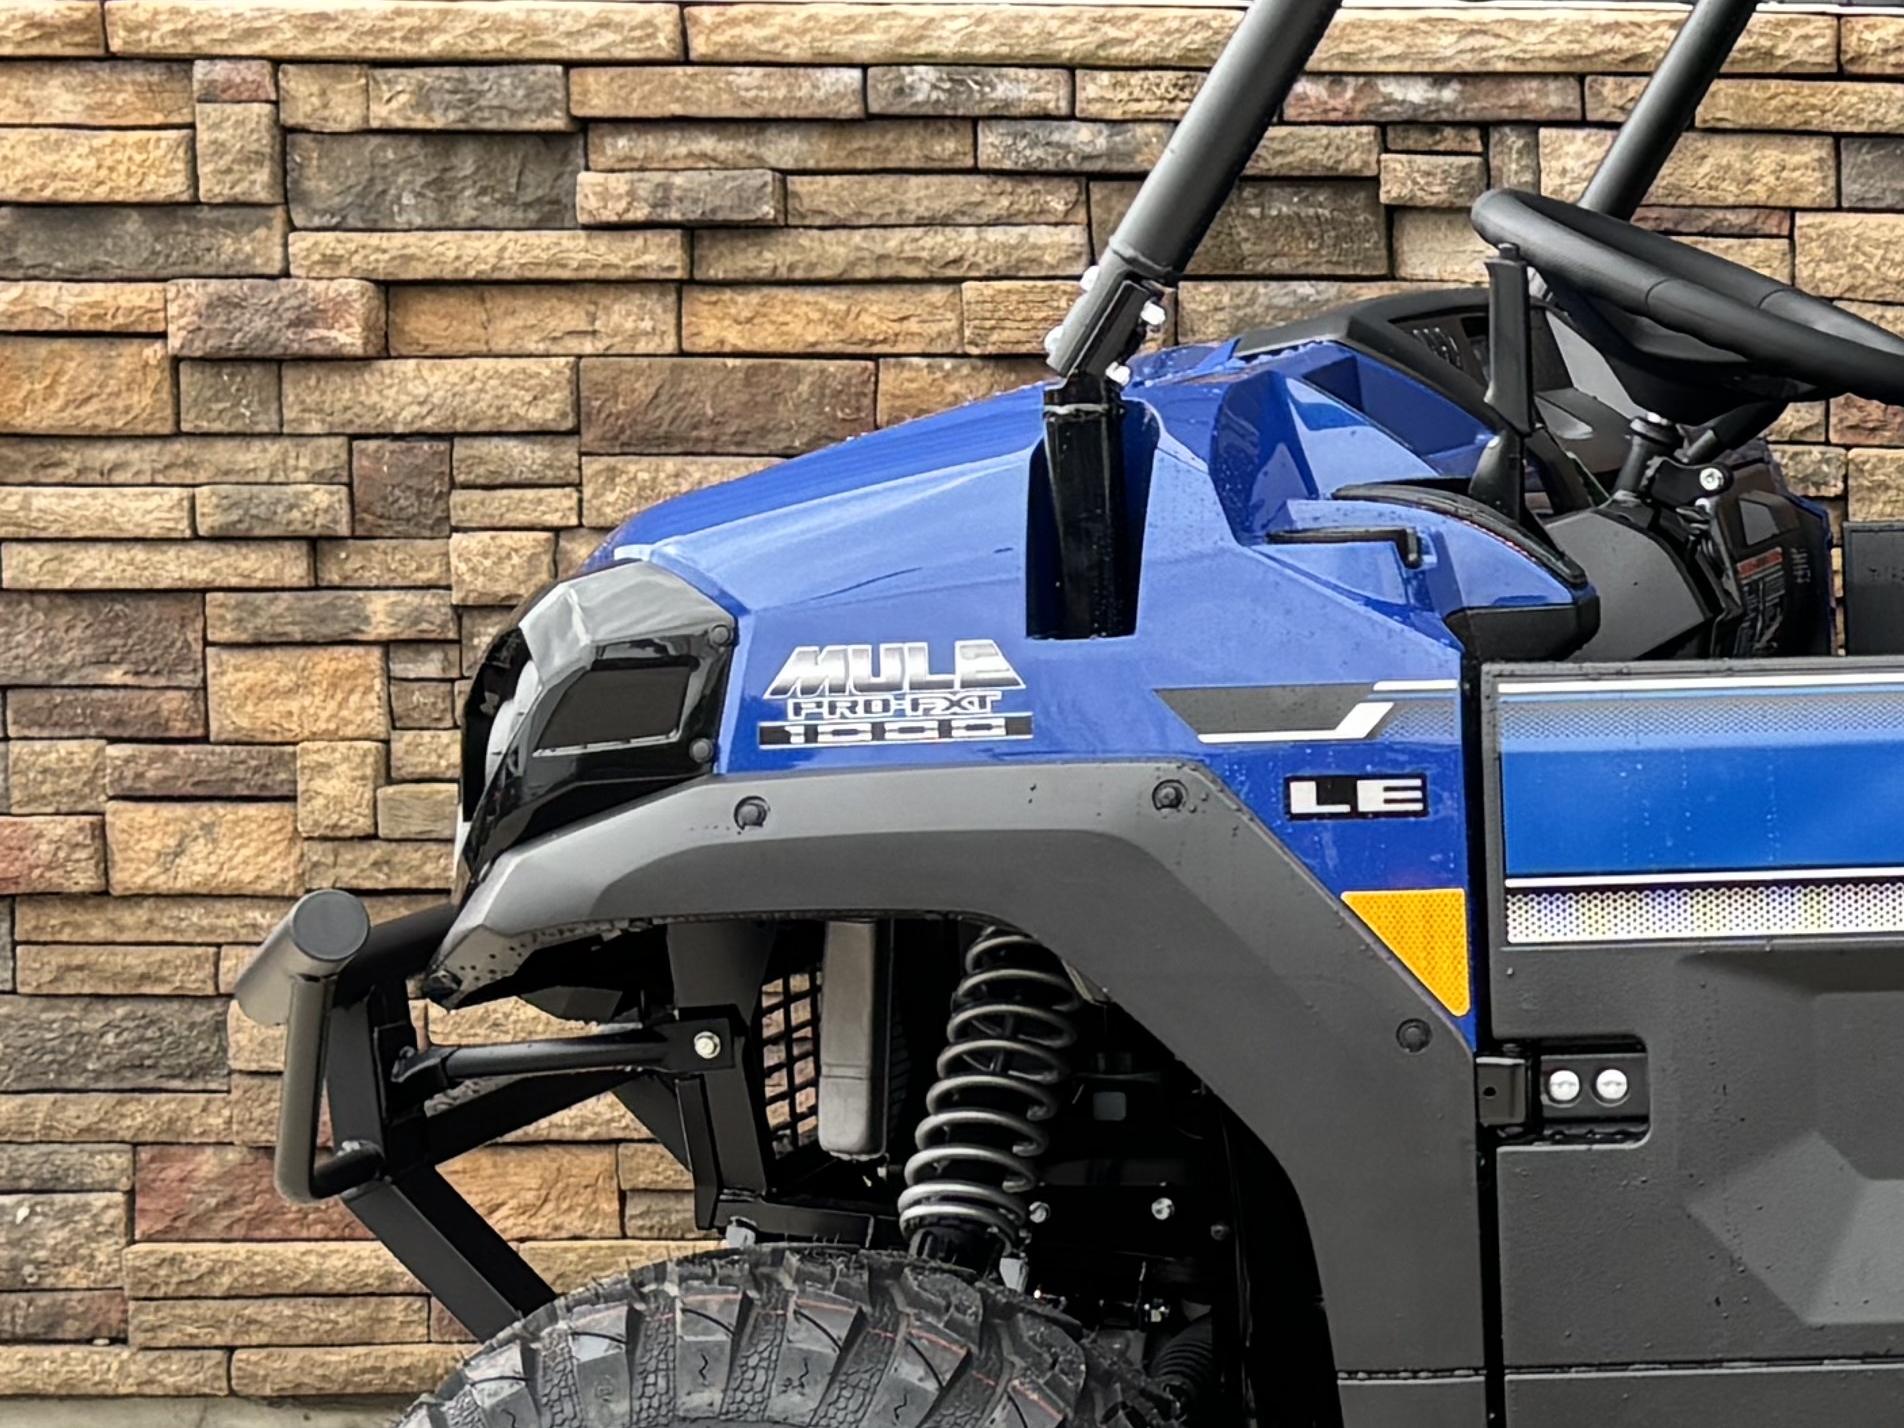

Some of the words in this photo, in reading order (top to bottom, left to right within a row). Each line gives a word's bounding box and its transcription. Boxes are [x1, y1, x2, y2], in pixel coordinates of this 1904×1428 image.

[763, 639, 1026, 699] MULE
[787, 691, 1003, 721] PRO-FXT
[785, 718, 1006, 744] 1000
[1289, 778, 1424, 814] LE
